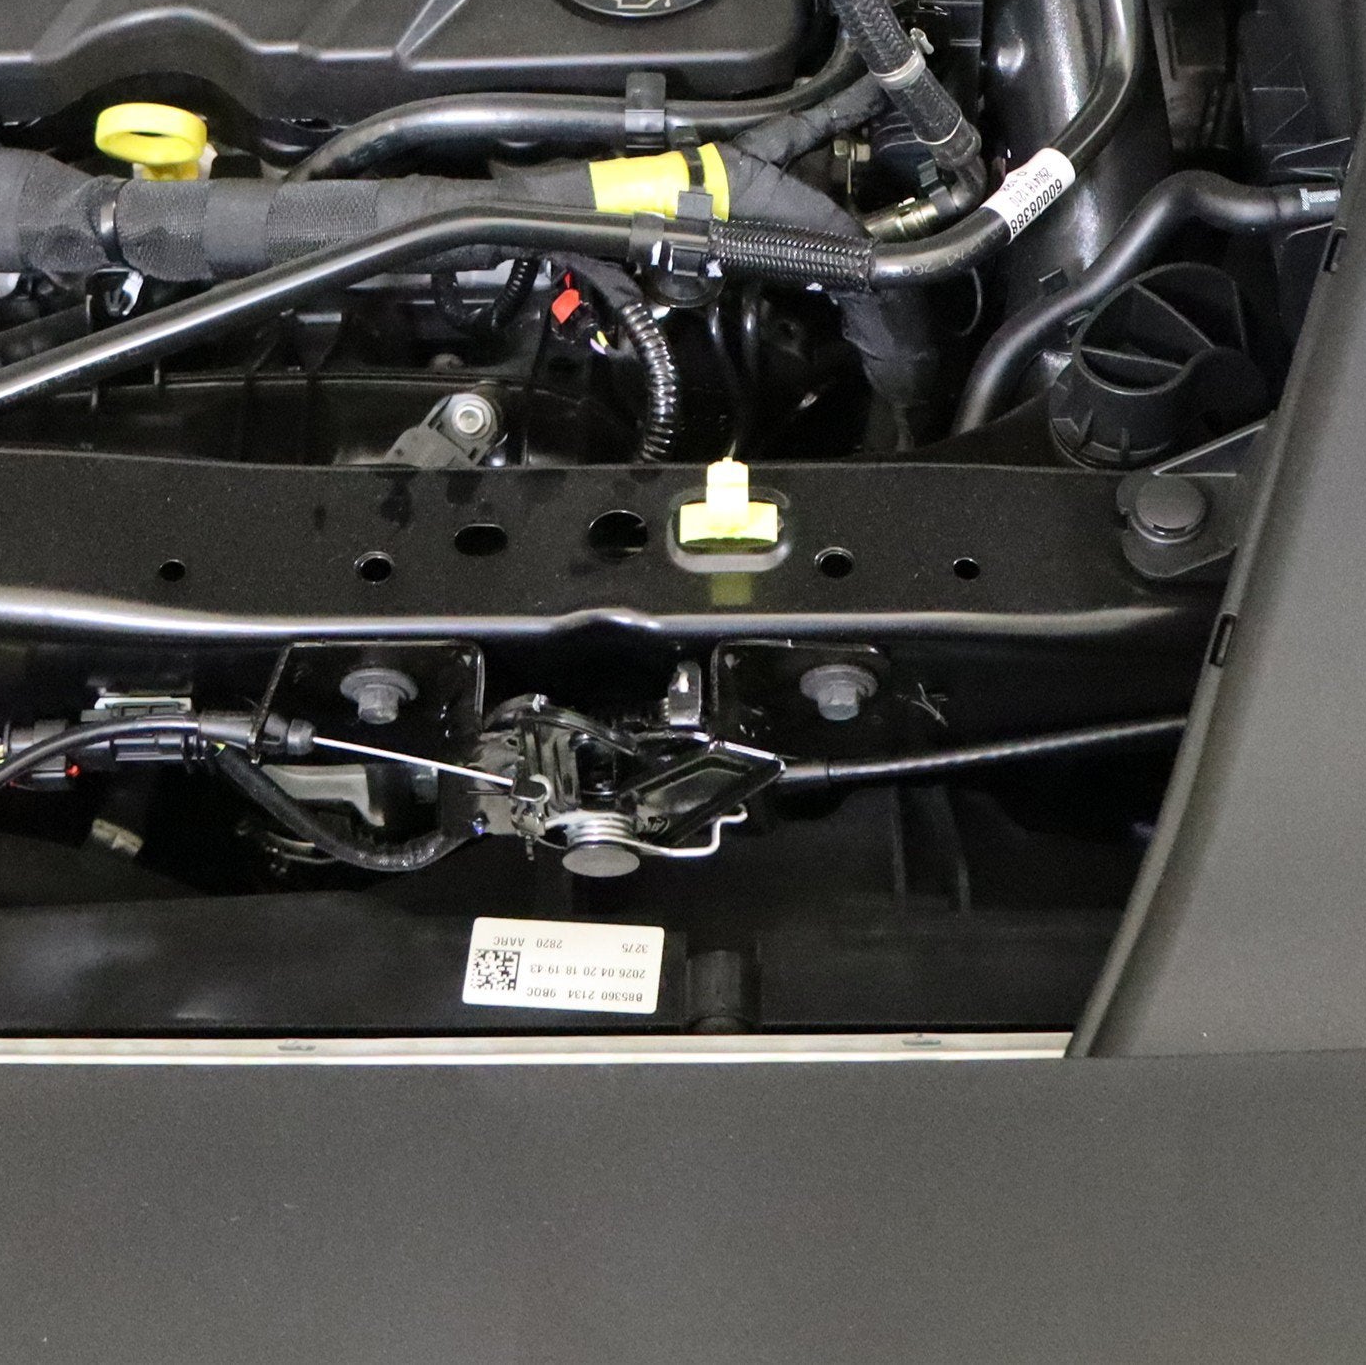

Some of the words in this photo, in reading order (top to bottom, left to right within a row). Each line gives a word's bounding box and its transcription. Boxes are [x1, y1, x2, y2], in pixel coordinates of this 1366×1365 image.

[1010, 178, 1063, 235] 60008388
[536, 938, 563, 949] 2820
[568, 989, 595, 1000] 2134
